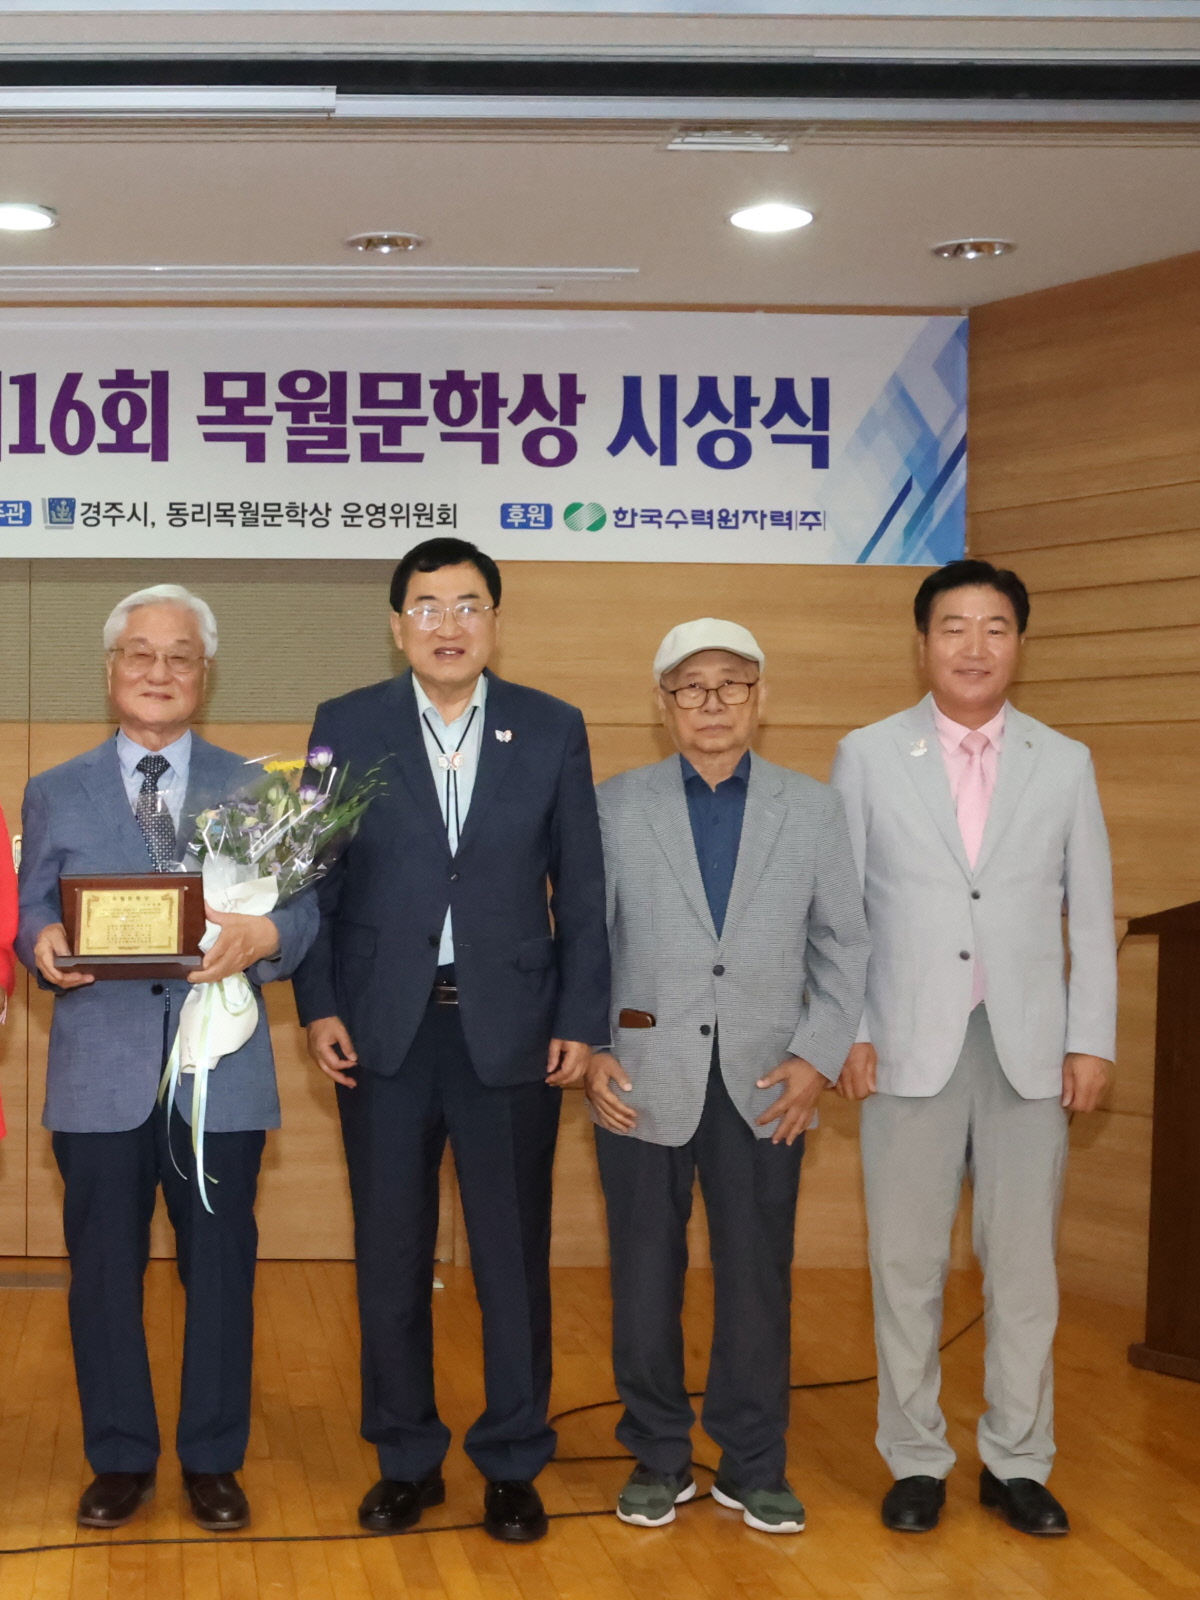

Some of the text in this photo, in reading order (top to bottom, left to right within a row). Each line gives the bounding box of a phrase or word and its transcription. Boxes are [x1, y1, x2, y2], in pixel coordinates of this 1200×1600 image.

[196, 369, 587, 468] 목월문학상
[606, 374, 830, 470] 시상식
[80, 501, 156, 530] 경주시,
[166, 501, 332, 529] 동리목월문학상
[340, 502, 459, 530] 운영위원회
[507, 504, 545, 528] 후원
